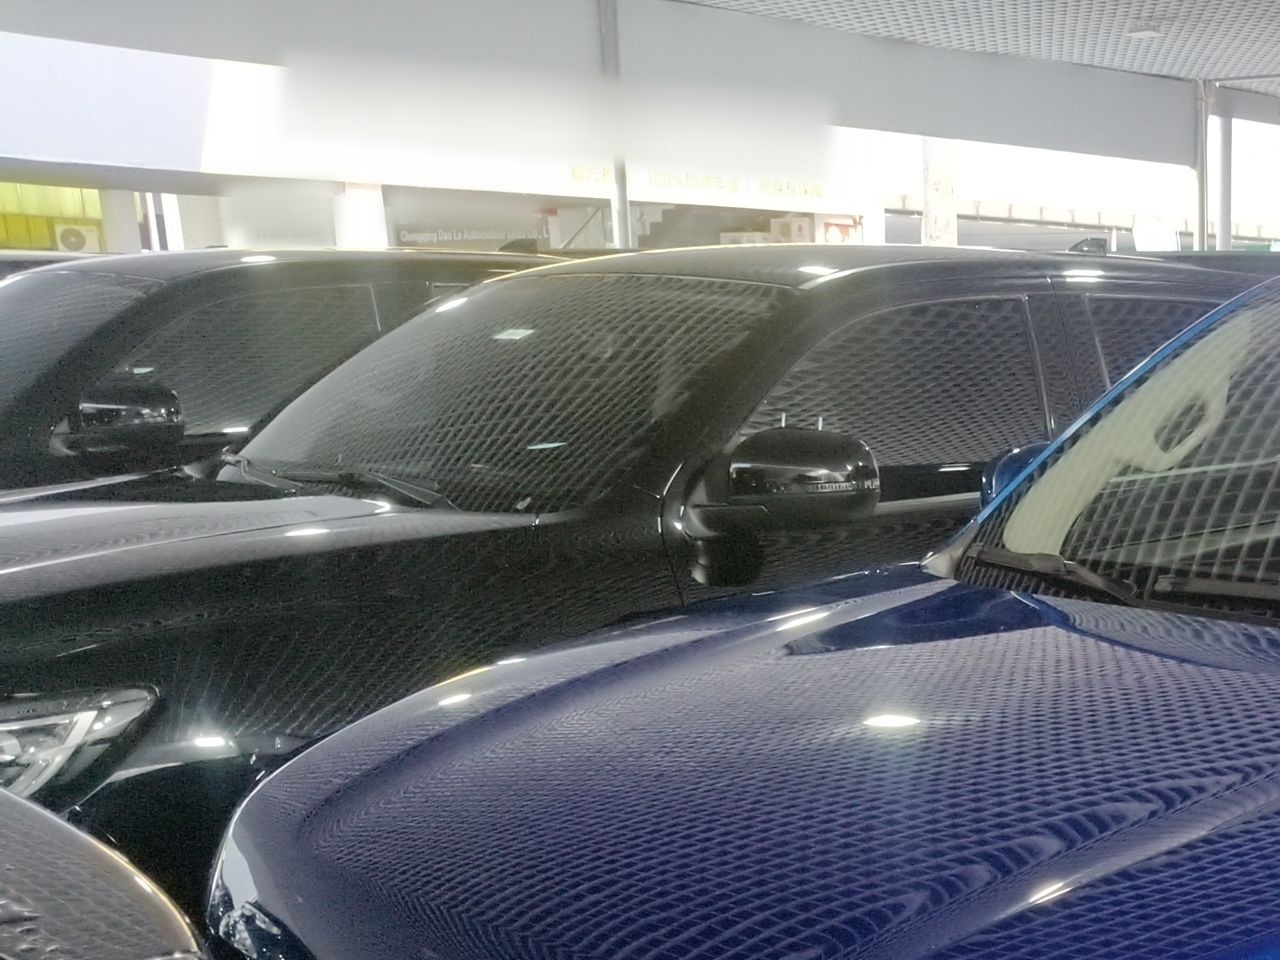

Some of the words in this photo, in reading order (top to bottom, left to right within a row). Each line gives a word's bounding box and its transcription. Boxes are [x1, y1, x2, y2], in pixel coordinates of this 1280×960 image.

[401, 230, 438, 243] Chongqing
[438, 229, 453, 241] Dao
[453, 229, 463, 241] Le
[463, 229, 506, 240] Automobile
